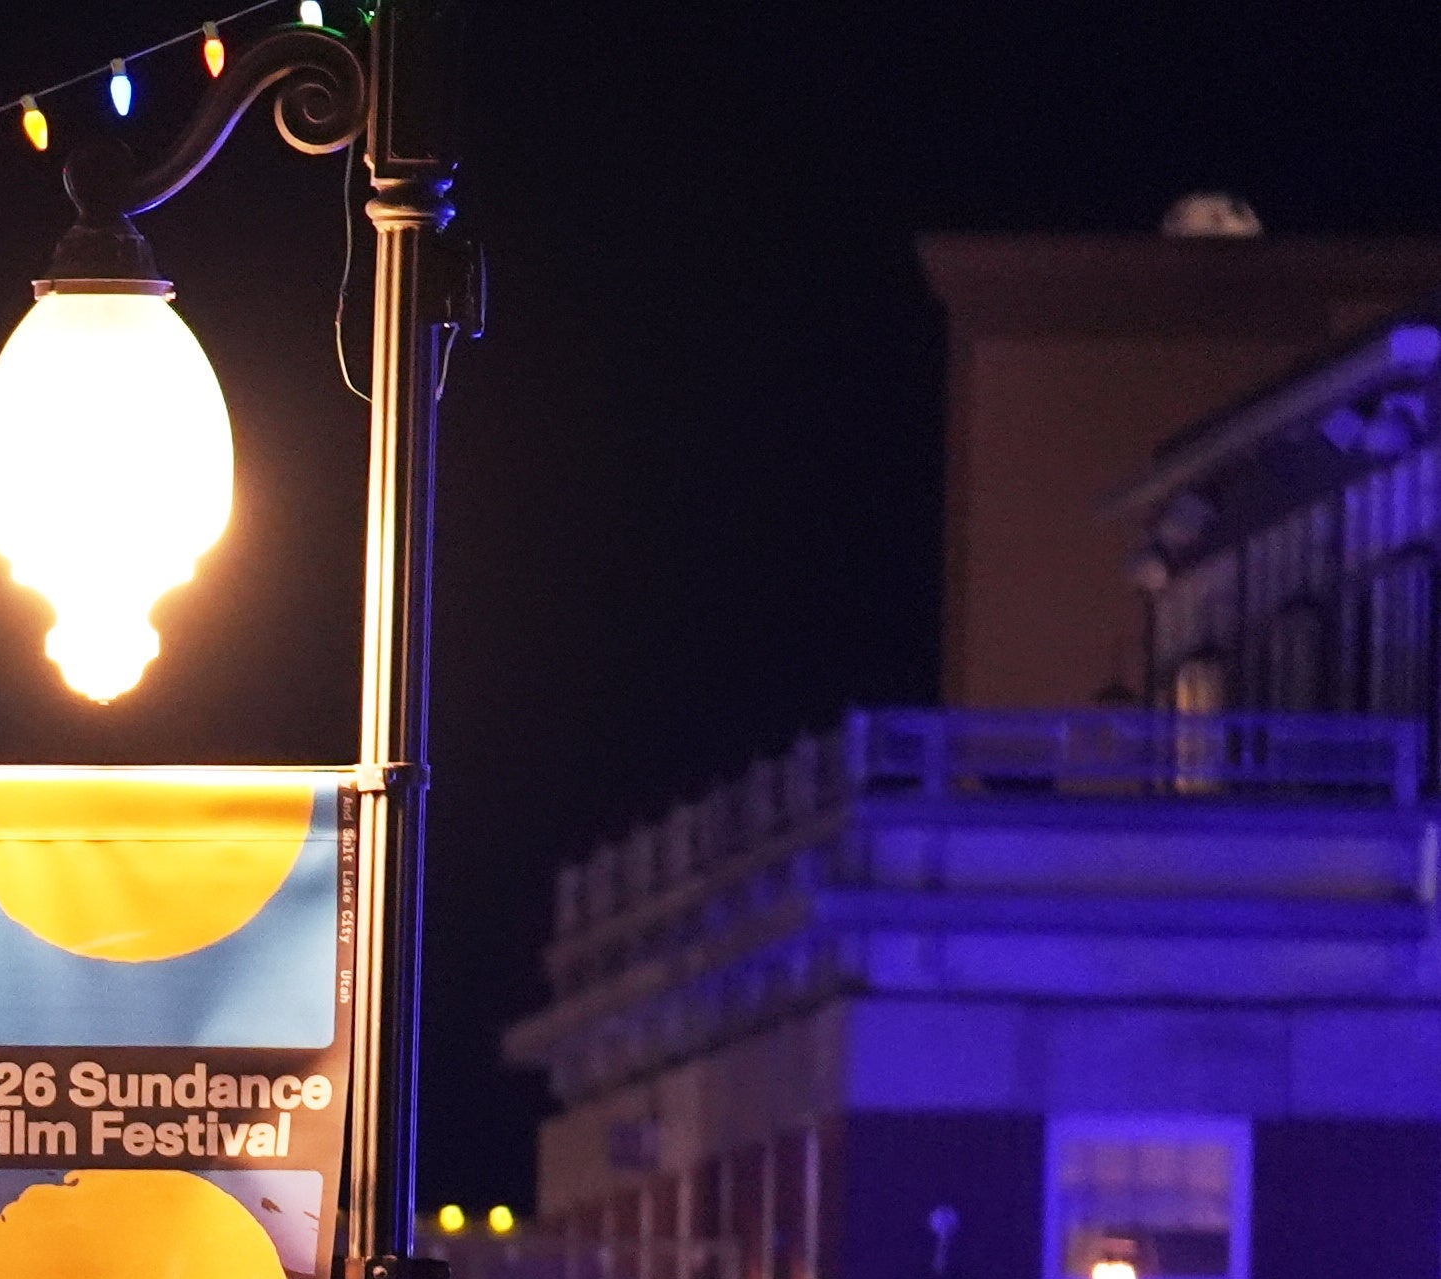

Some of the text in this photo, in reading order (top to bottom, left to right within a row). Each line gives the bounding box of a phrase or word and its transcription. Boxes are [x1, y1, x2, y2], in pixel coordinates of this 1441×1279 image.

[342, 796, 354, 821] And
[342, 828, 355, 862] Salt
[342, 871, 354, 903] Lake
[339, 909, 354, 944] City
[339, 970, 352, 1004] Utah
[68, 1062, 333, 1110] Sundance
[91, 1111, 291, 1157] Festival
